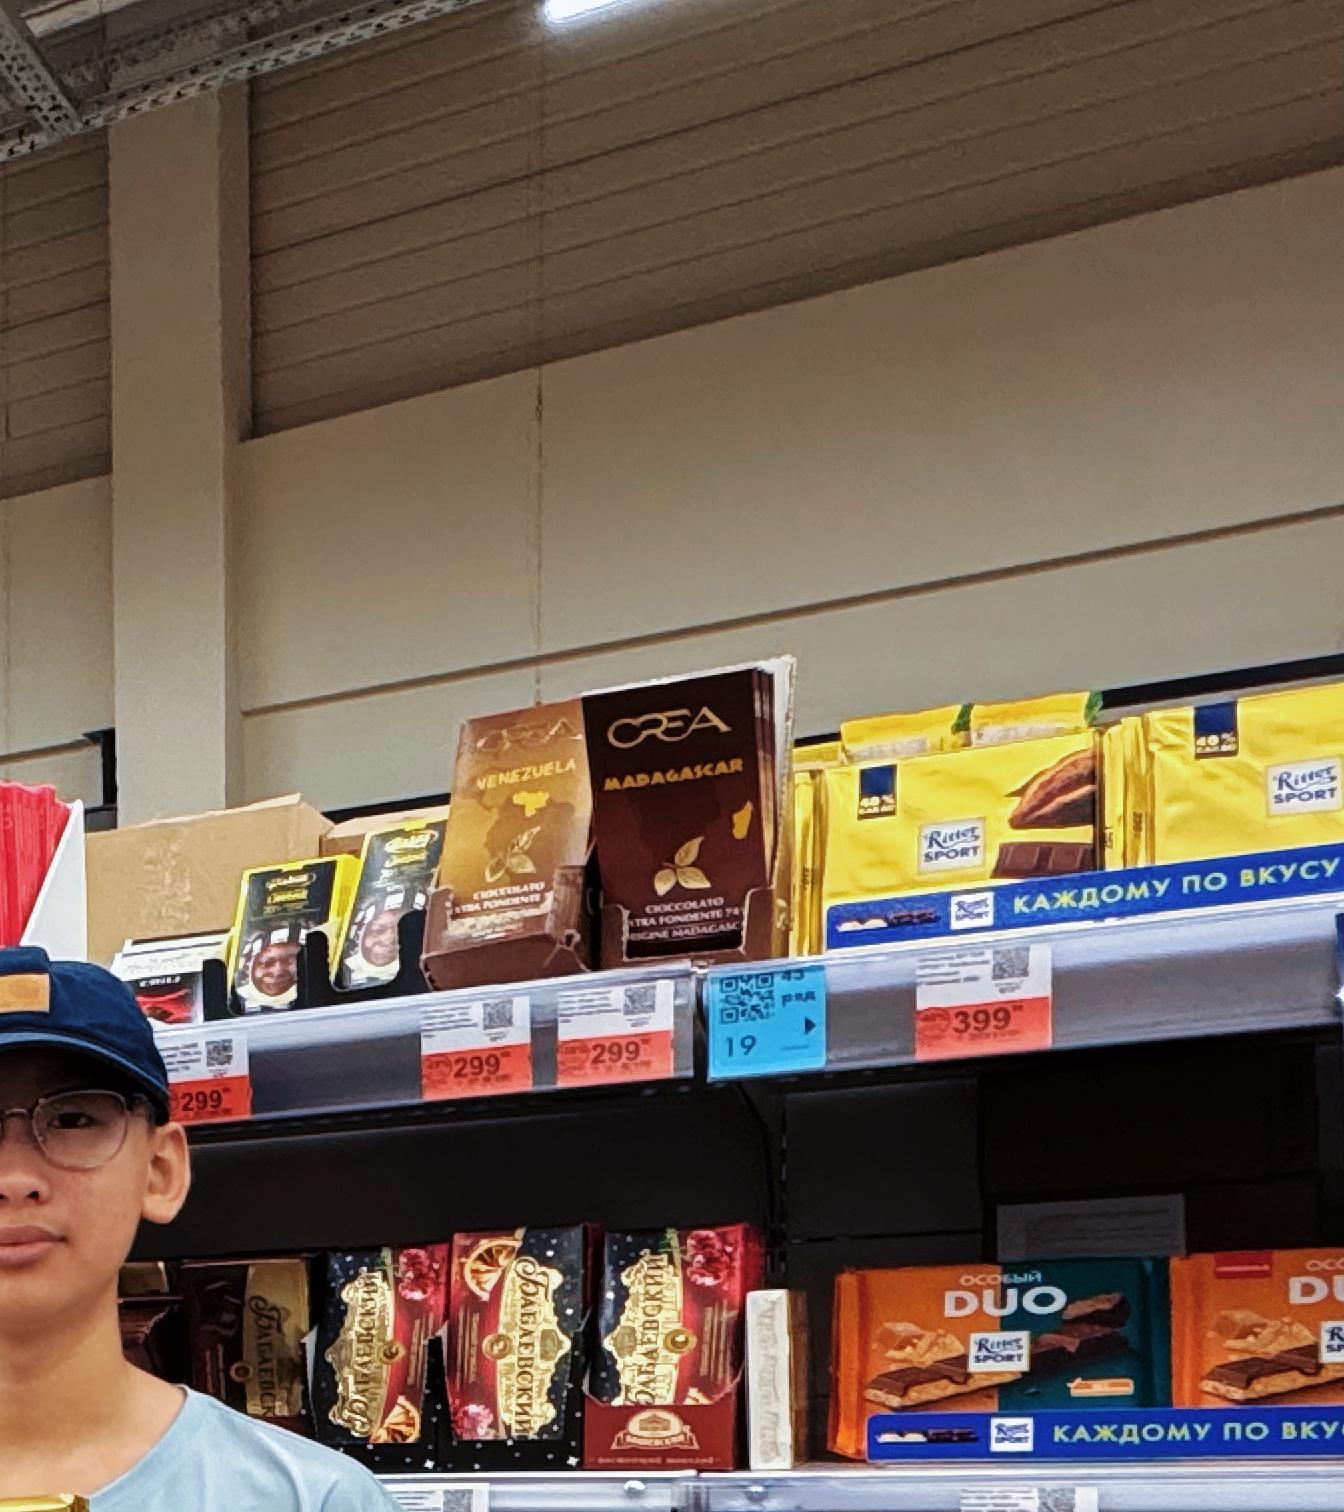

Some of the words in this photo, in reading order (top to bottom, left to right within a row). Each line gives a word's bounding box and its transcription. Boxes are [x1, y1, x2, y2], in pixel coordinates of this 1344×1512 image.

[607, 705, 731, 749] CREA
[476, 756, 576, 792] VENEZUELA
[603, 756, 743, 792] MADAGASCAR
[1275, 766, 1336, 790] Ritter
[1273, 787, 1337, 806] SPORT
[924, 826, 979, 850] Ritter
[923, 845, 980, 864] SPORT
[1014, 877, 1169, 914] КАЖДОМУ
[1184, 869, 1227, 894] ПО
[1241, 857, 1340, 889] ВКУСУ
[644, 896, 724, 914] CIOCCOLATO
[952, 1007, 1011, 1033] 399
[591, 1039, 640, 1064] 299
[724, 1036, 756, 1058] 19
[454, 1052, 501, 1077] 299
[181, 1089, 223, 1113] 299
[959, 1270, 1042, 1286] ОСОБЫЙ
[944, 1285, 1067, 1317] DUO
[1053, 1422, 1210, 1444] КАЖДОМУ
[1223, 1422, 1269, 1441] ПО
